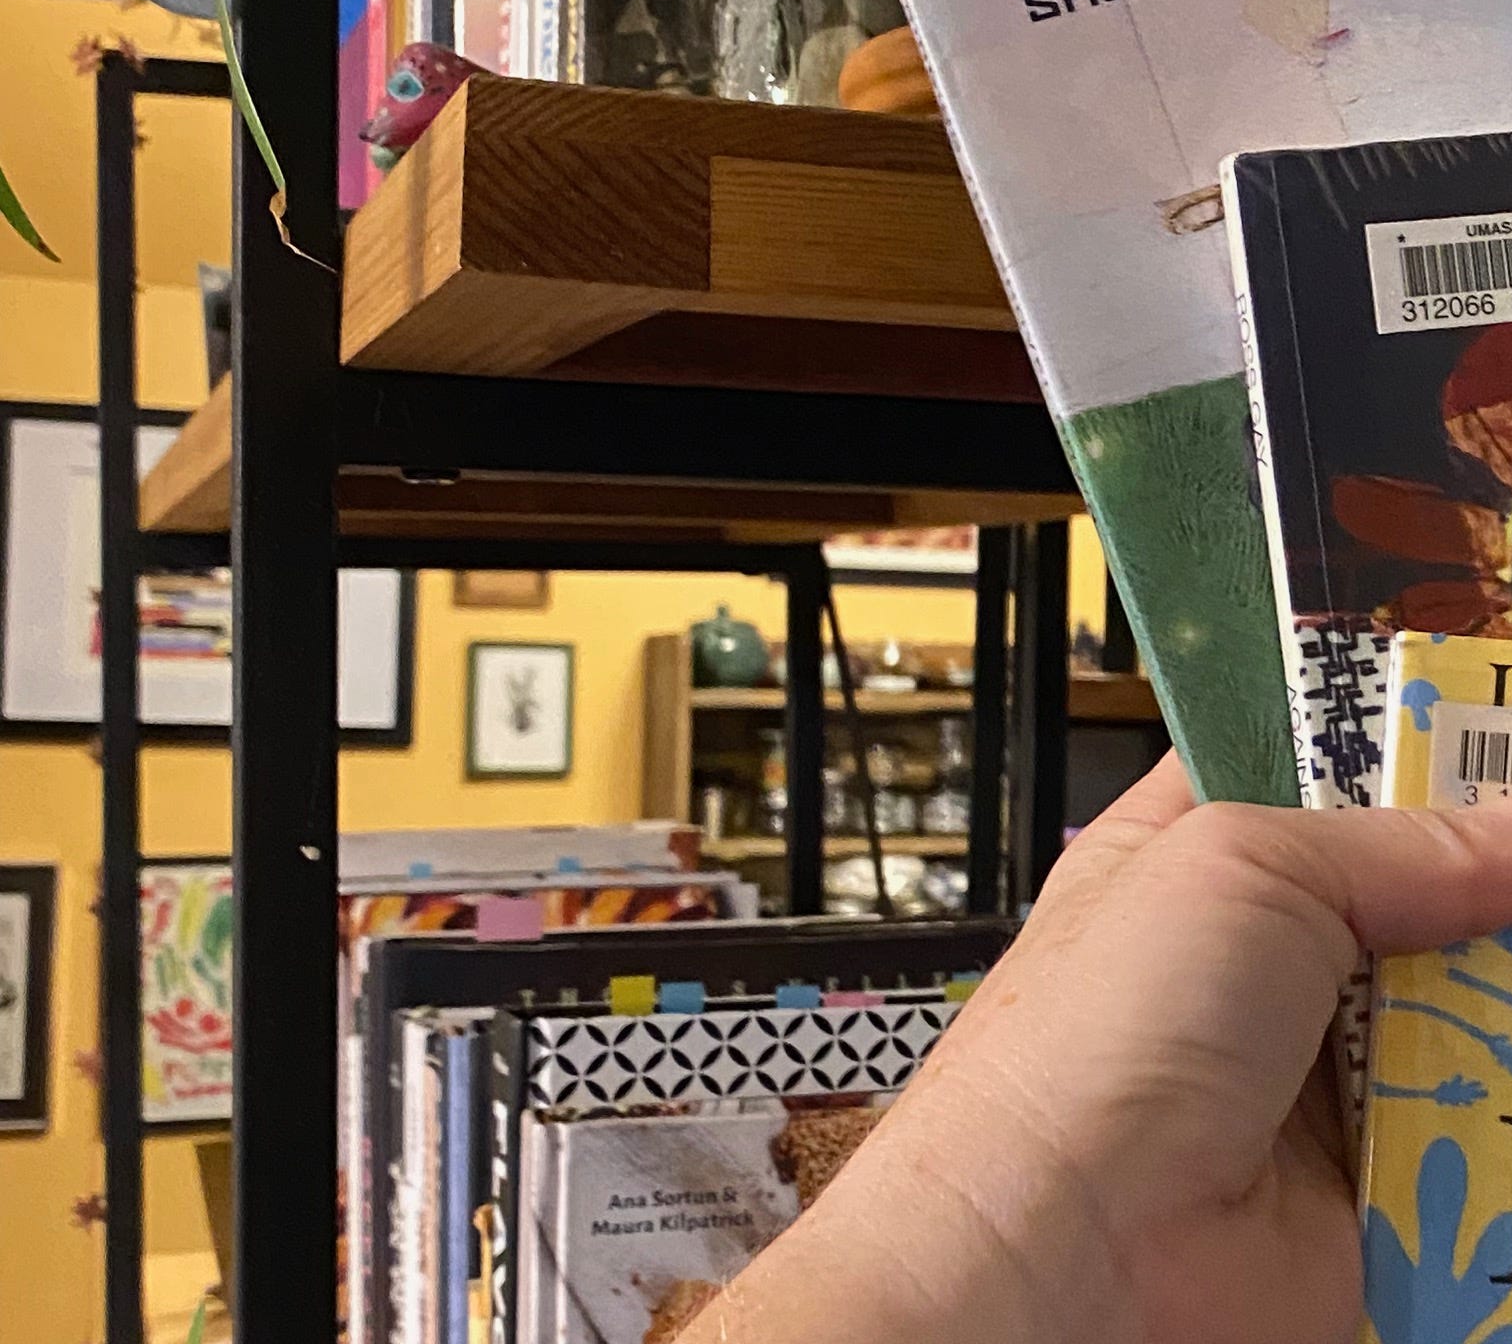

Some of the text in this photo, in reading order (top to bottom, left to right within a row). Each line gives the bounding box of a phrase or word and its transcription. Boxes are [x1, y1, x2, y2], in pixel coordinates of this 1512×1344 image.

[1402, 292, 1497, 323] 312066
[1252, 401, 1268, 467] GAY
[1464, 785, 1479, 807] 3
[608, 1186, 737, 1210] Ana Sortun &
[591, 1209, 754, 1236] Maura Kilpatrick
